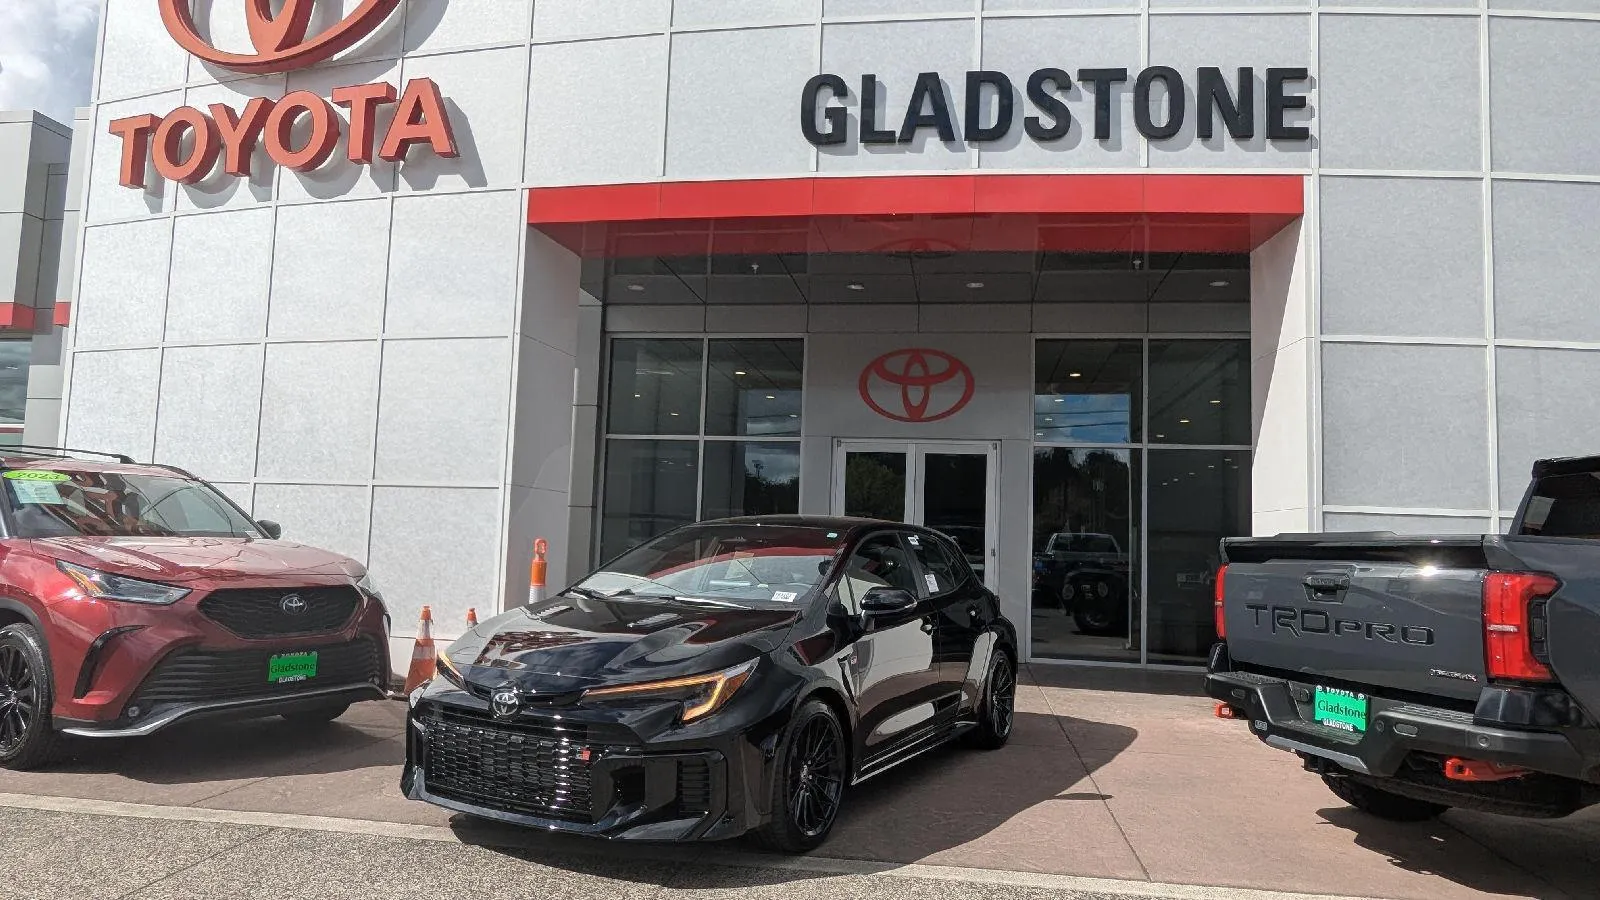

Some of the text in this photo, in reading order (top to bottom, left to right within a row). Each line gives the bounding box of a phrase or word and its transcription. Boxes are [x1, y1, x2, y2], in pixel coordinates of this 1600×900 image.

[800, 66, 1310, 145] GLADSTONE
[109, 77, 460, 189] TOYOTA
[271, 663, 314, 673] Gladstone
[279, 674, 306, 683] GLADSTONE
[1325, 686, 1354, 698] TOYOTA
[1318, 700, 1367, 719] Gladstone
[1322, 718, 1354, 732] GLADSTONE
